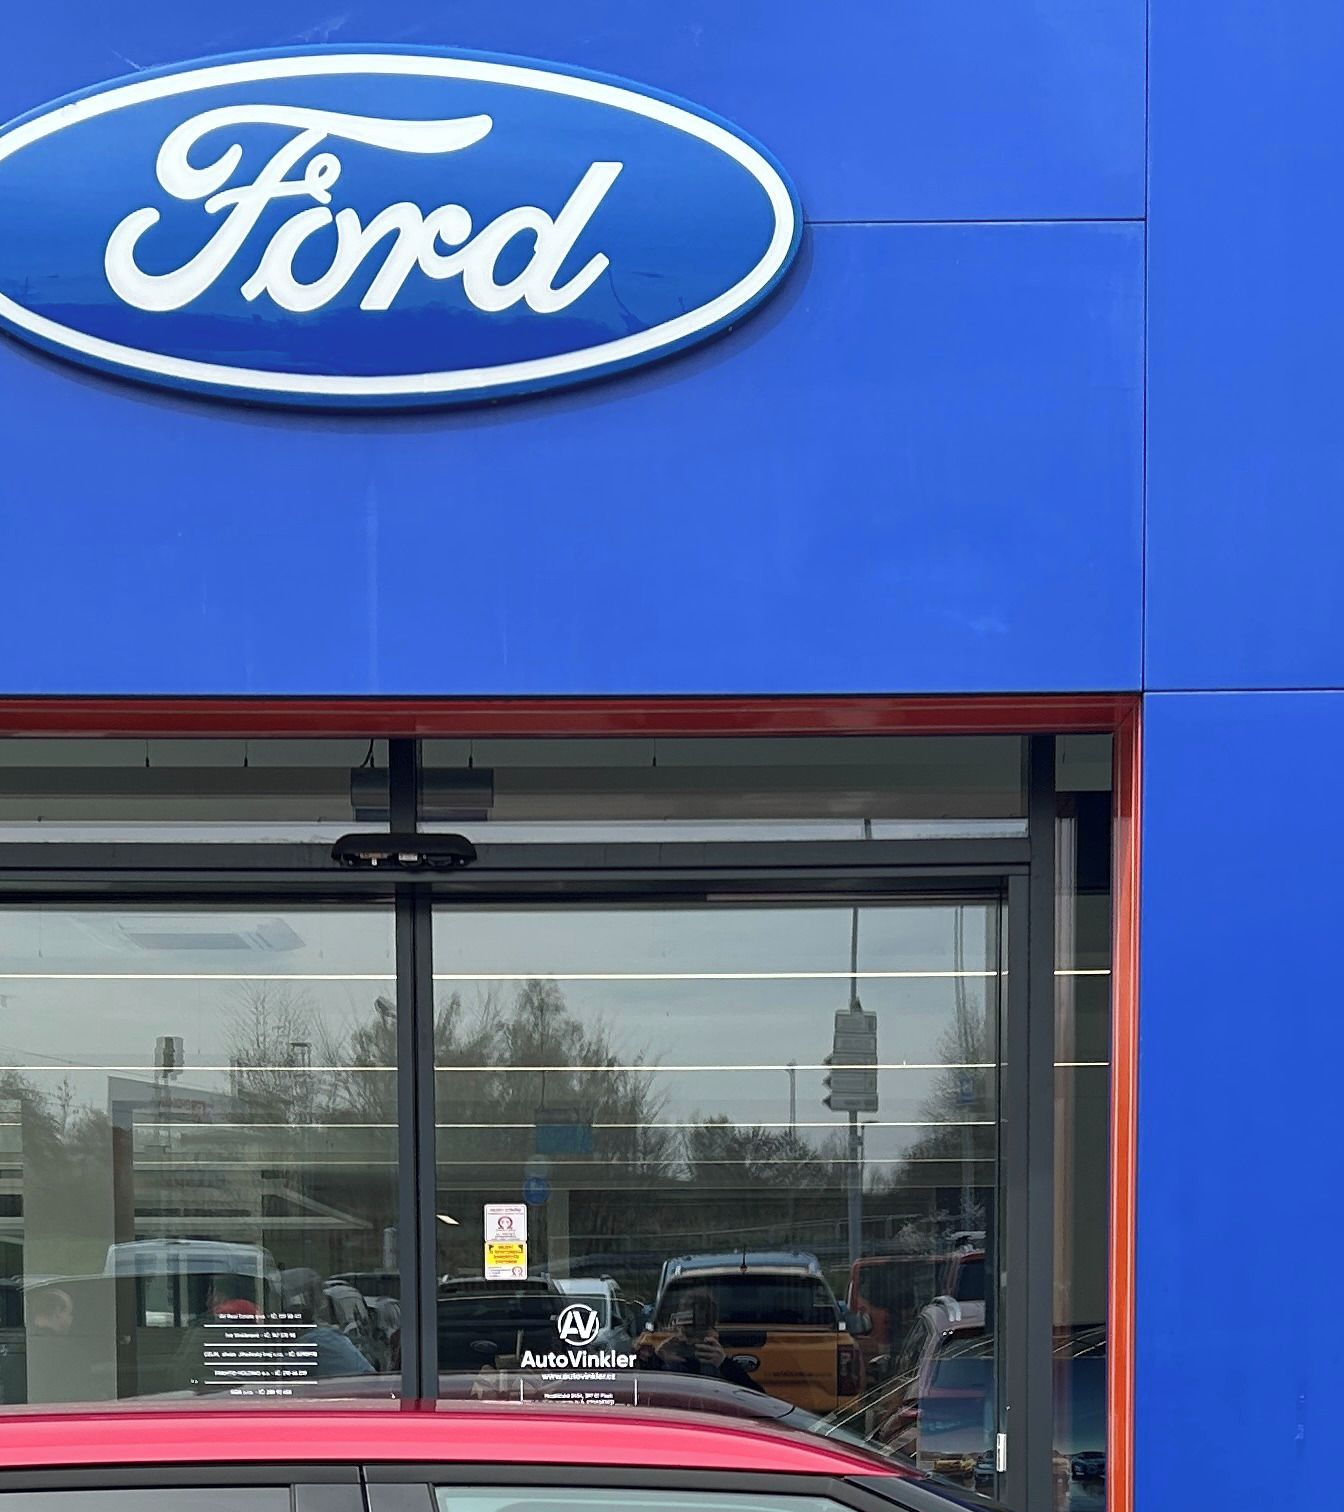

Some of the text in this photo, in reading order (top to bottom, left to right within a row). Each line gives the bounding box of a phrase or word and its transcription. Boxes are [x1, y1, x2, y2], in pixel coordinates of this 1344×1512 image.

[104, 104, 623, 313] Ford
[559, 1310, 598, 1339] AV
[520, 1350, 637, 1368] AutoVinkler
